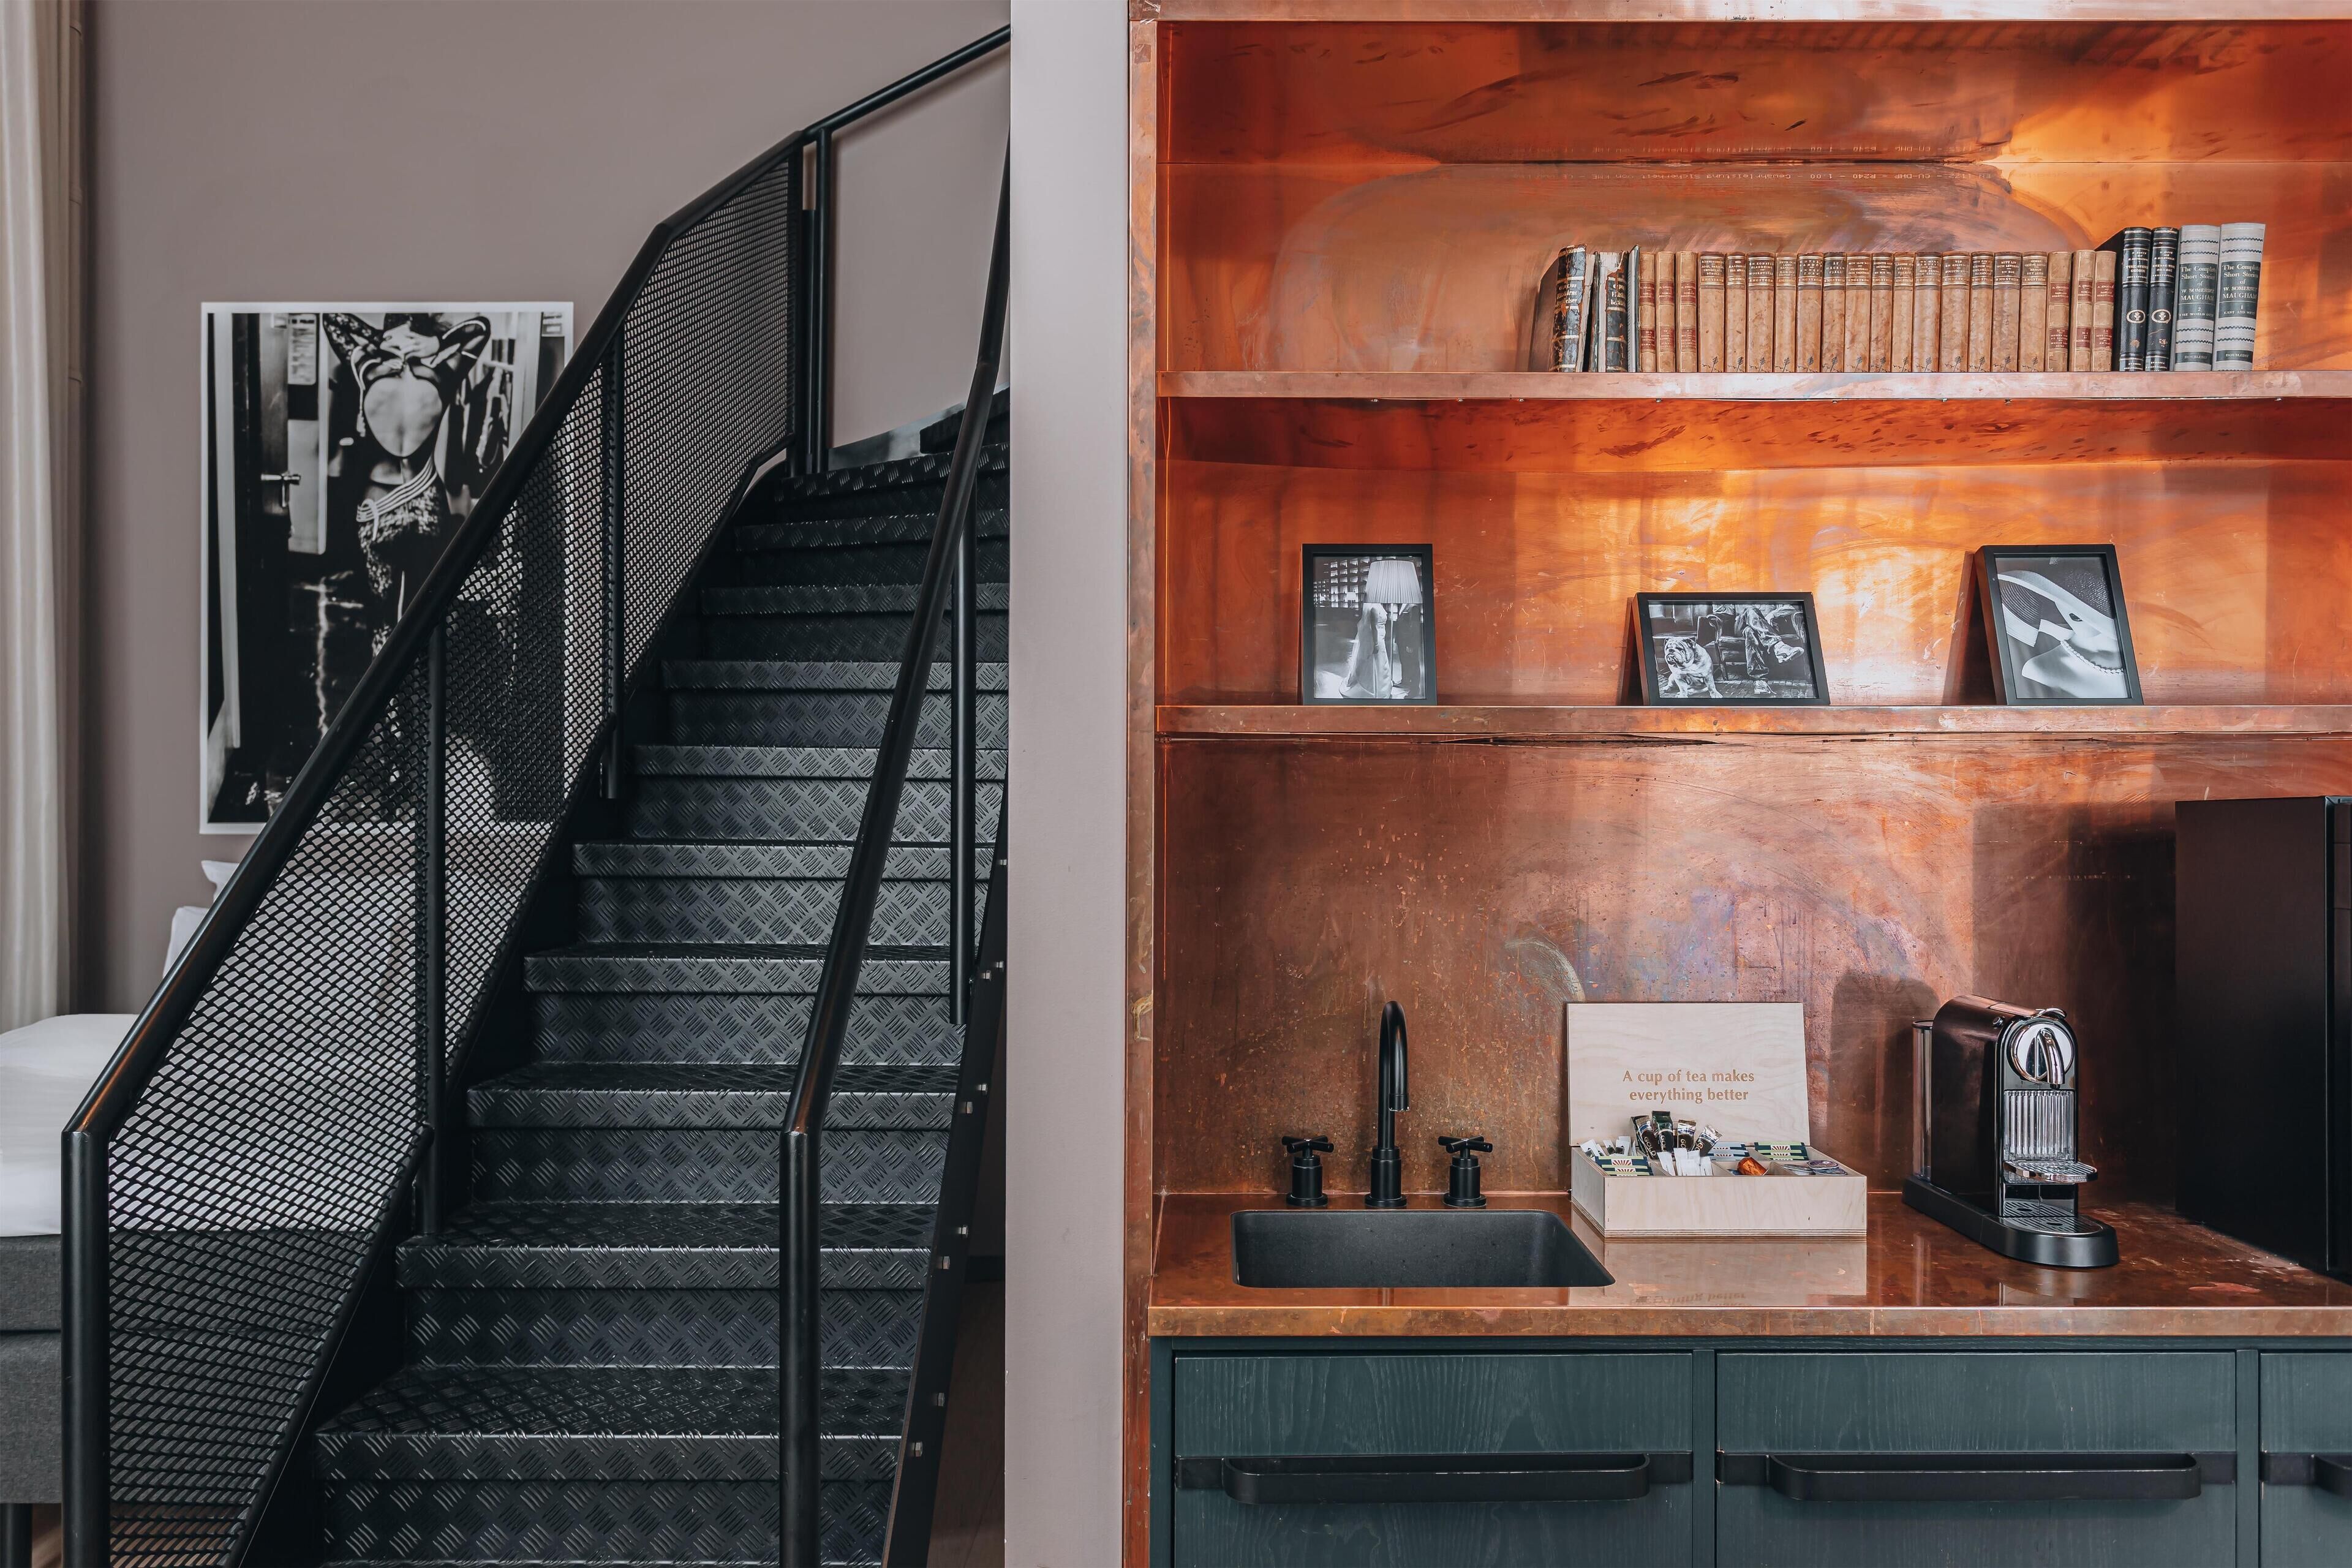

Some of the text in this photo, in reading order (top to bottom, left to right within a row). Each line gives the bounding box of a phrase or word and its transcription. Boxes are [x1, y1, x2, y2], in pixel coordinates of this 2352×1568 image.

[1623, 1069, 1755, 1085] A cup of tea makes
[1629, 1088, 1749, 1104] everything better
[1644, 1136, 1657, 1156] GOLD
